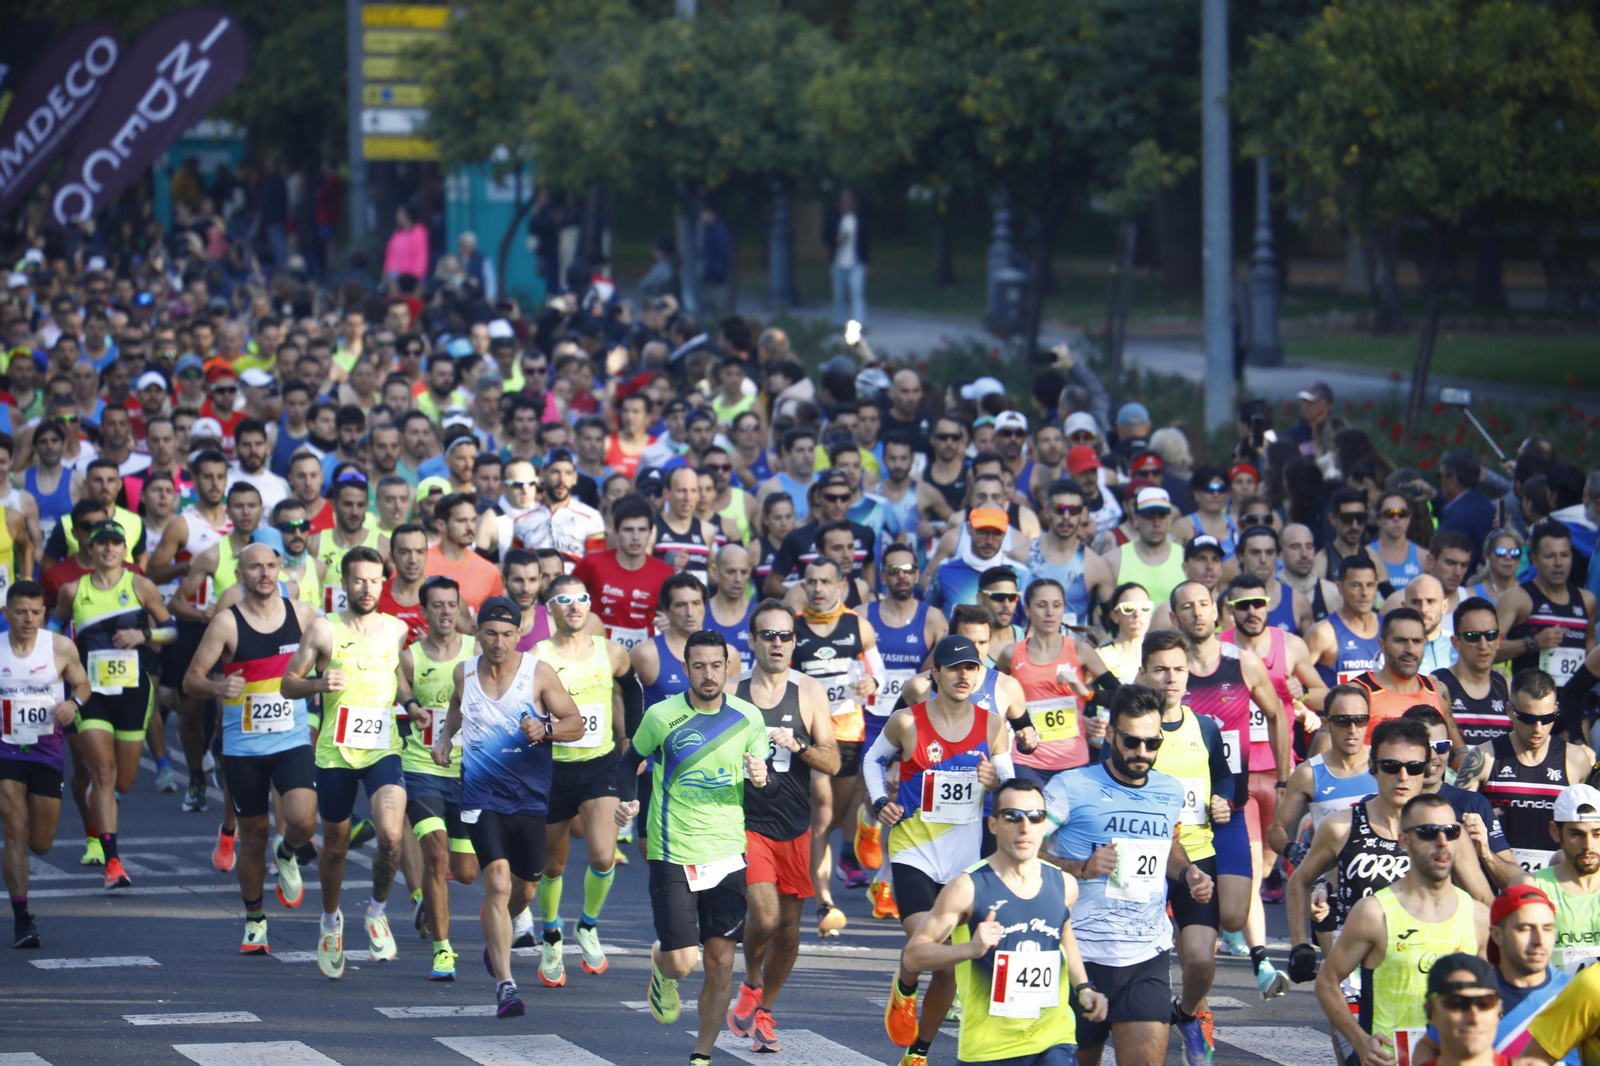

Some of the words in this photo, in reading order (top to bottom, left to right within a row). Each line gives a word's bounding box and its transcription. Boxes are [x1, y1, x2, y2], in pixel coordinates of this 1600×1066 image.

[53, 17, 231, 226] IMDECO
[107, 660, 127, 675] 55
[1561, 658, 1577, 674] 82
[827, 685, 846, 702] 62
[17, 707, 47, 723] 160
[252, 701, 291, 720] 2296
[1045, 709, 1065, 728] 66
[352, 718, 383, 735] 229
[940, 782, 973, 801] 381
[1180, 790, 1196, 809] 9
[1136, 854, 1158, 876] 20
[1015, 966, 1053, 988] 420
